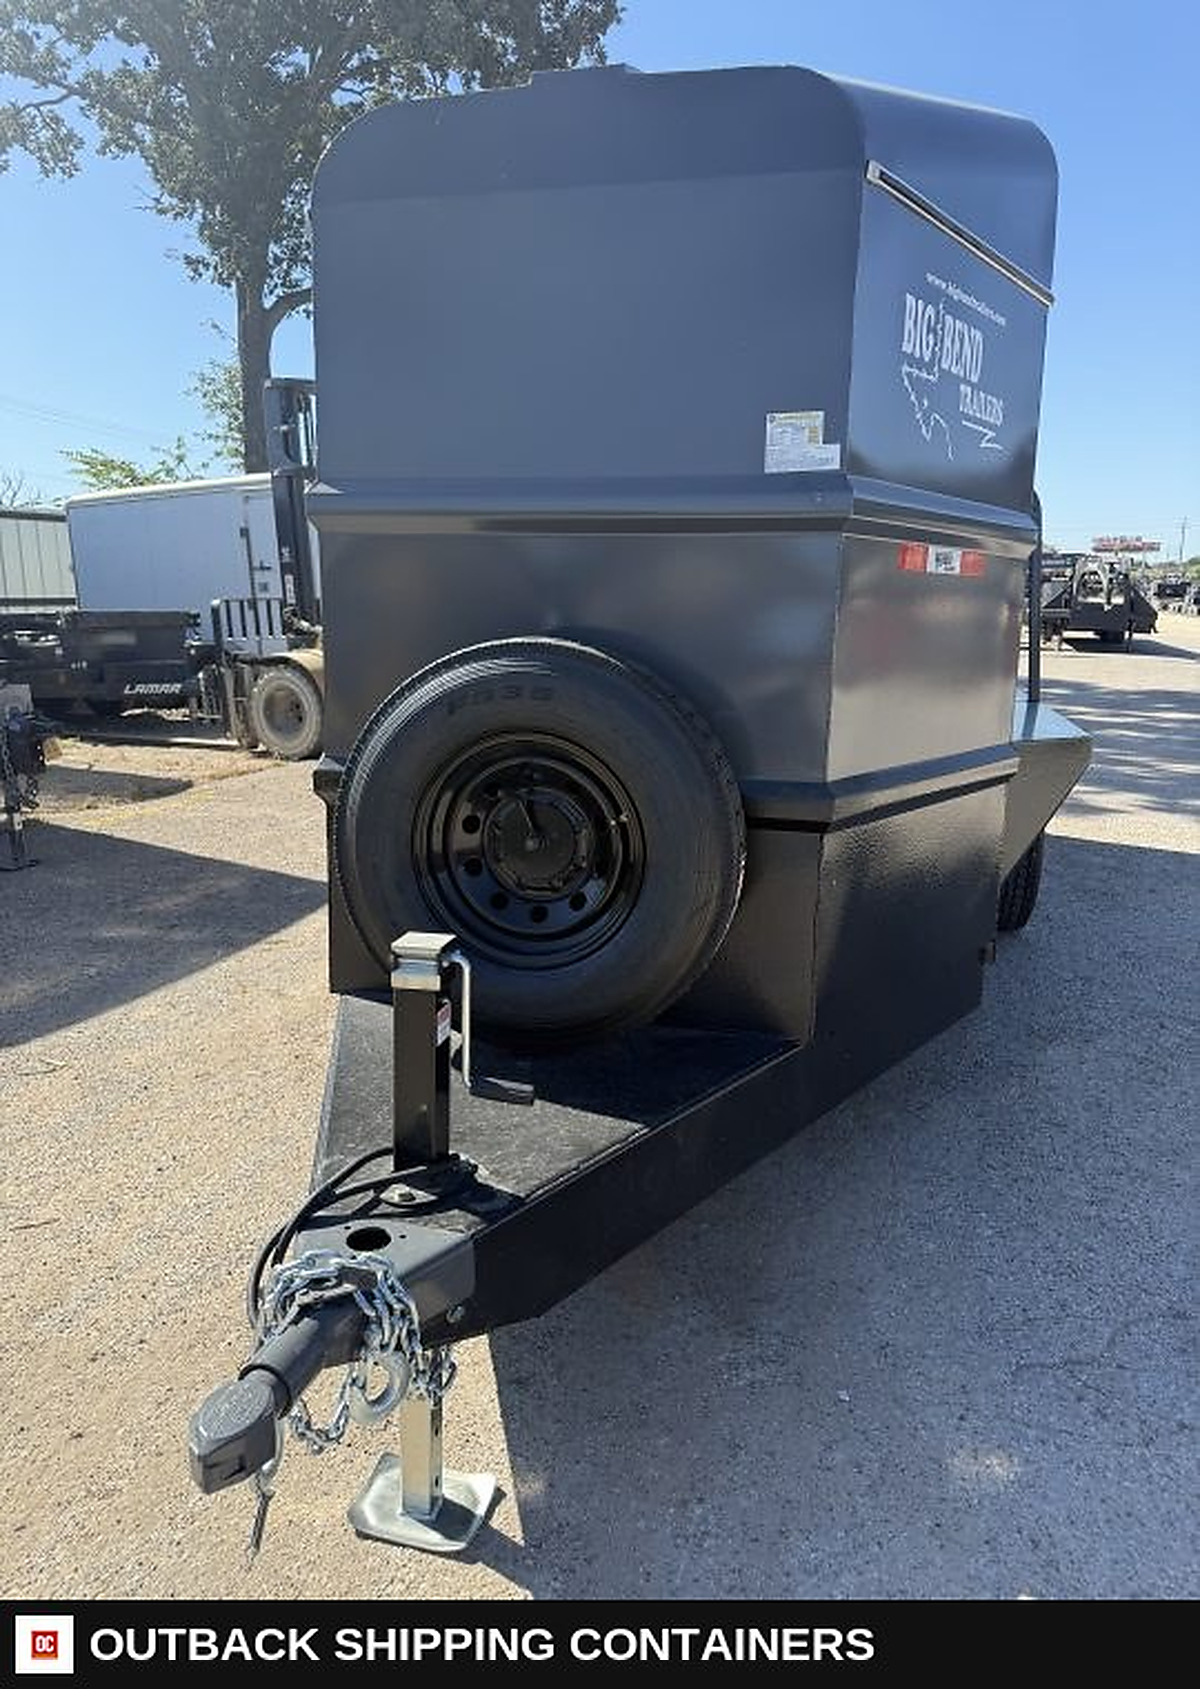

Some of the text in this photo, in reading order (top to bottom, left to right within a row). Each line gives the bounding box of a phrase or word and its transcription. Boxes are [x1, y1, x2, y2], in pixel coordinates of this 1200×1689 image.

[902, 293, 934, 362] BIG
[941, 314, 984, 383] BEND
[959, 384, 1005, 427] TRAILERS
[124, 683, 182, 695] LAMAR
